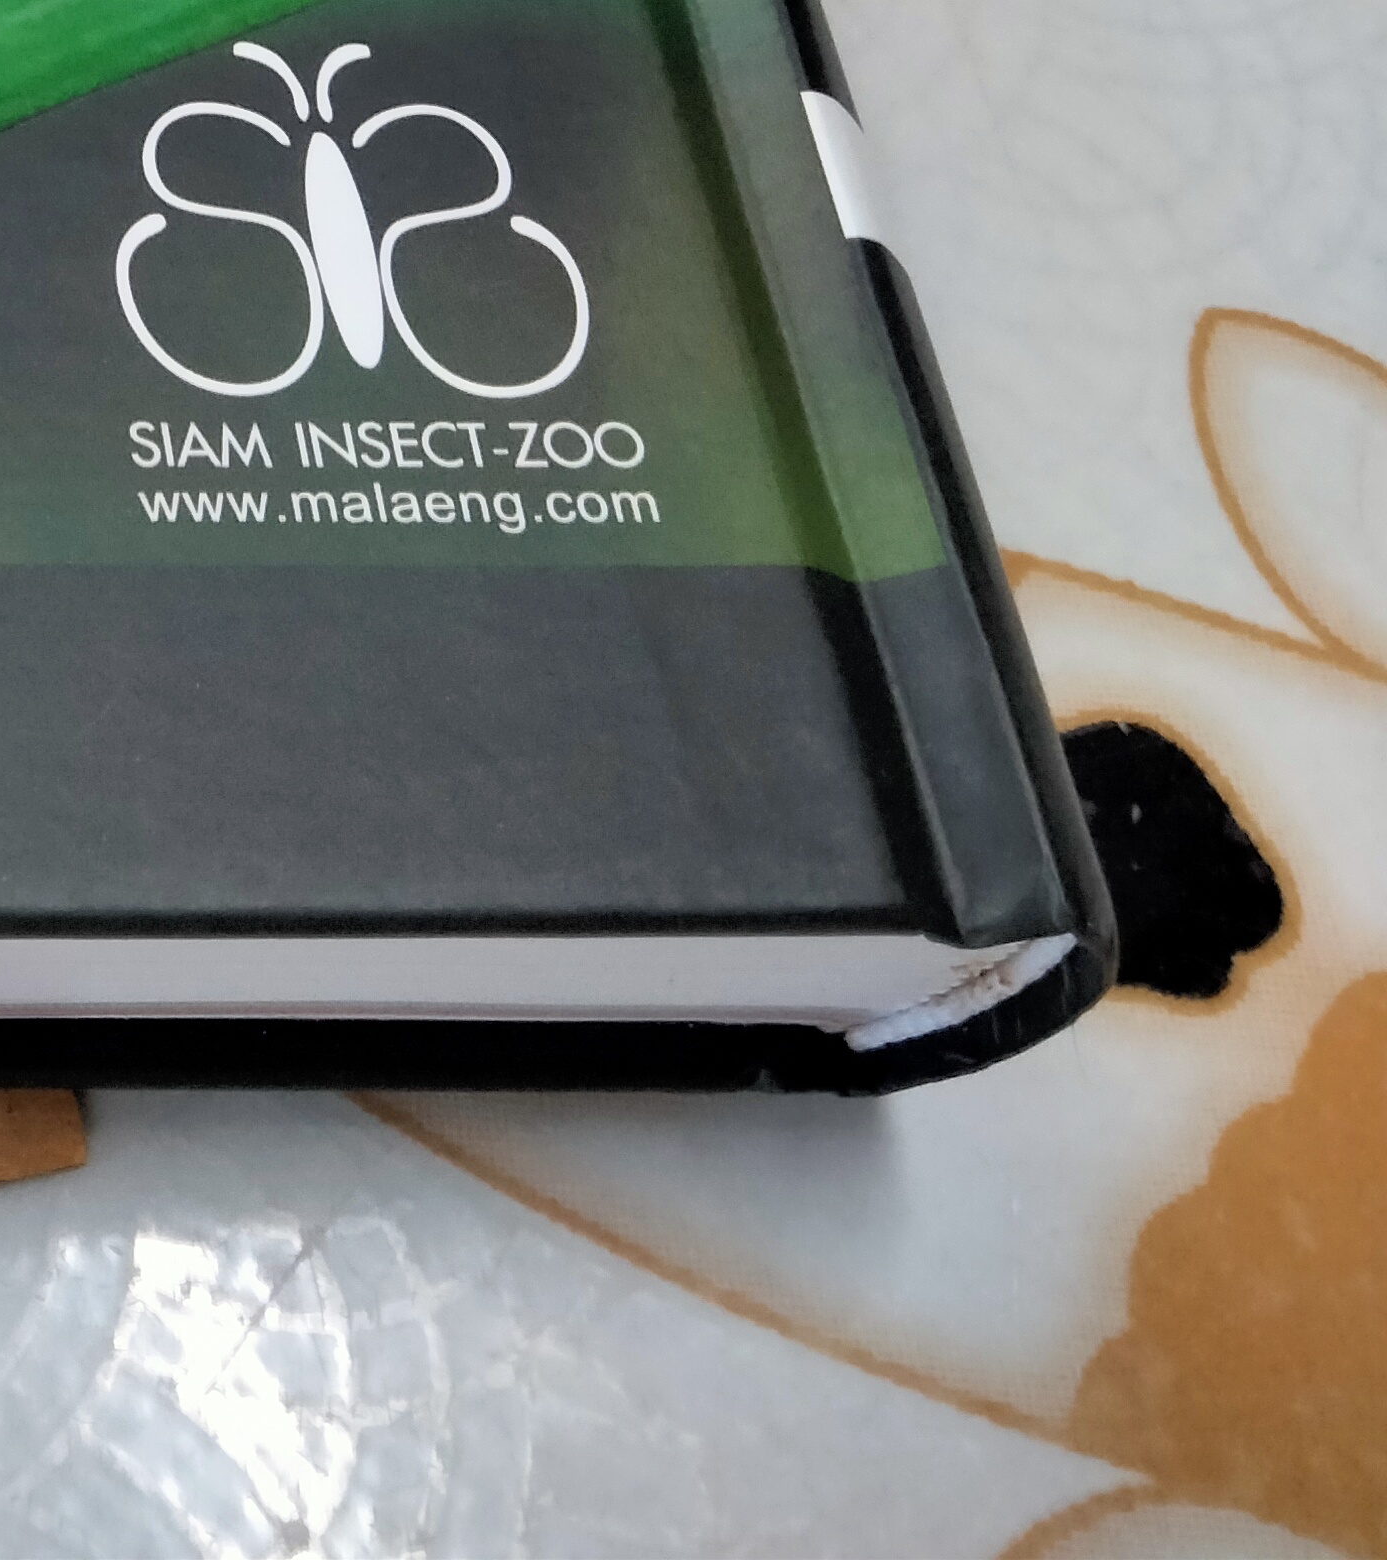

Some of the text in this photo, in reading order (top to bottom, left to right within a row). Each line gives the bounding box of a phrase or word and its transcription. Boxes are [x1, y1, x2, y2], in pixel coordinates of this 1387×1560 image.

[129, 420, 645, 469] SIAM INSECT-ZOO
[137, 481, 661, 535] www.malaeng.com
